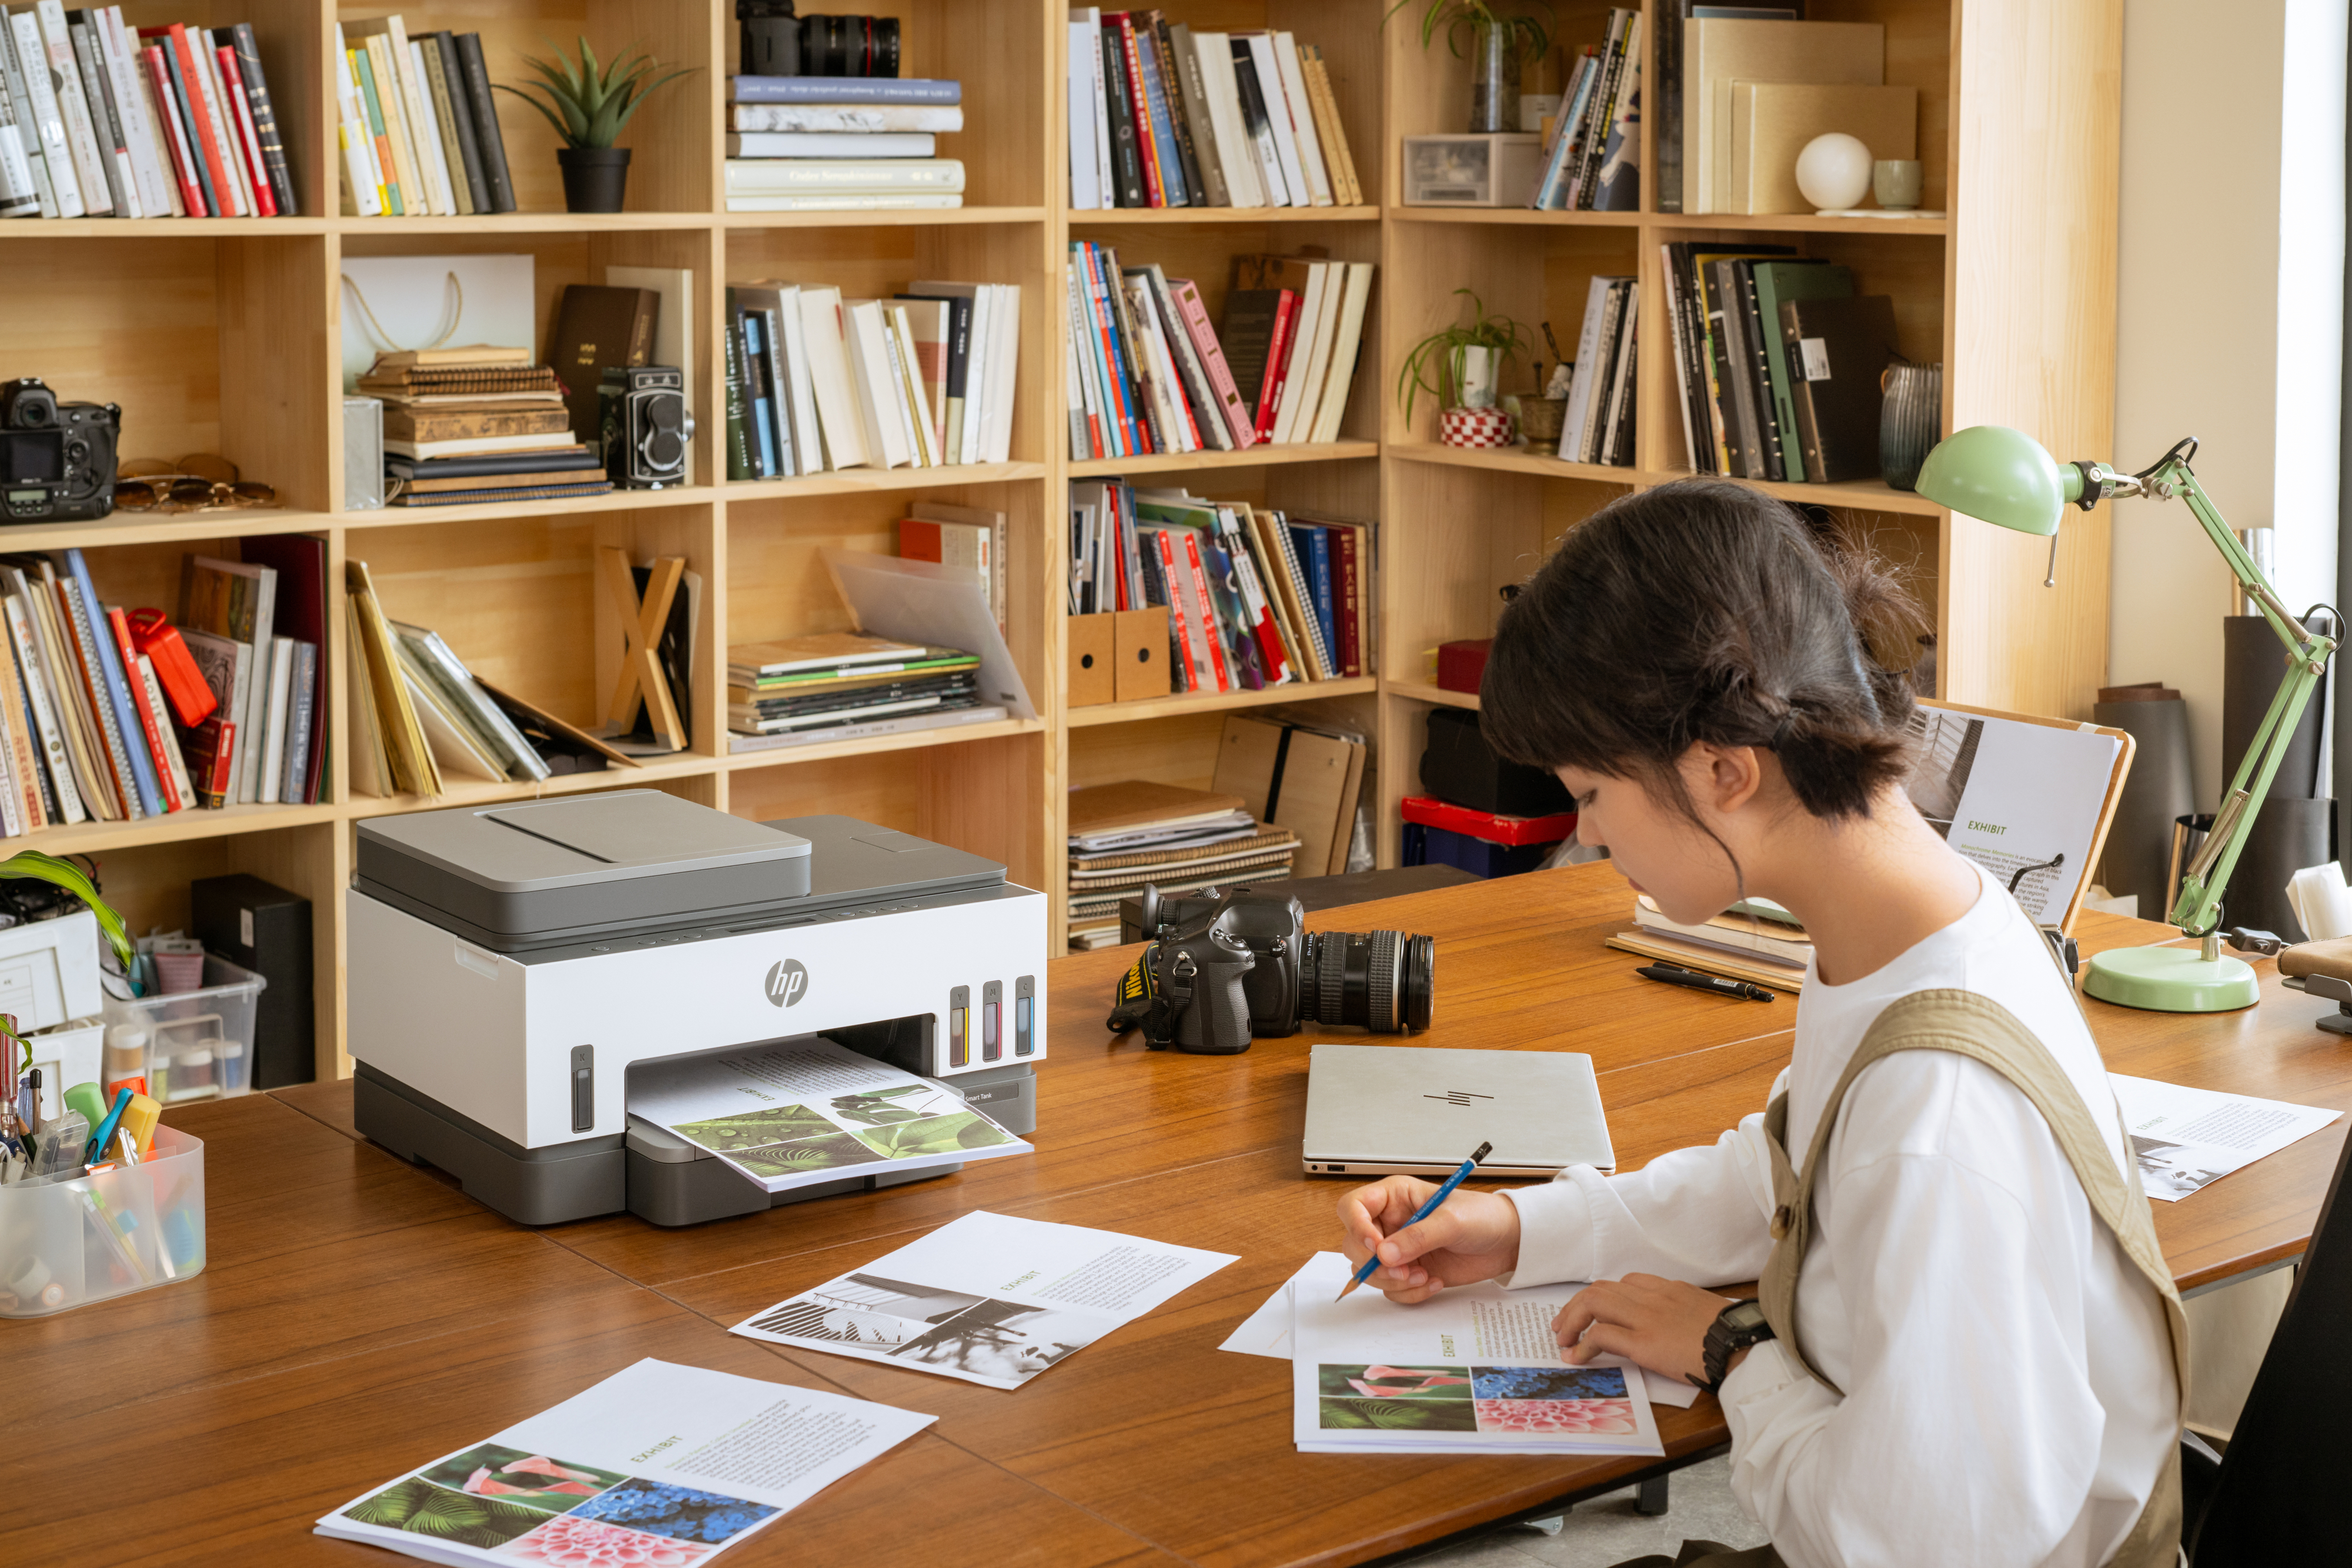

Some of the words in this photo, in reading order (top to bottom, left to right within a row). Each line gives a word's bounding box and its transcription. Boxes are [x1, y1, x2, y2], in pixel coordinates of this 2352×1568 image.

[142, 673, 163, 719] MOVIE
[1968, 821, 2007, 835] EXHIBIT
[1960, 844, 1991, 854] Monochrome
[1992, 850, 2014, 858] Memories
[1978, 860, 2006, 870] photography.
[2010, 860, 2027, 868] timeless
[770, 959, 805, 1008] hp
[737, 1087, 776, 1101] EXHIBIT
[965, 1094, 980, 1102] Smart
[2137, 1116, 2169, 1129] EXHIBIT
[1000, 1271, 1041, 1291] EXHIBIT
[1442, 1335, 1455, 1357] EXHIBIT
[631, 1436, 683, 1463] EXHIBIT
